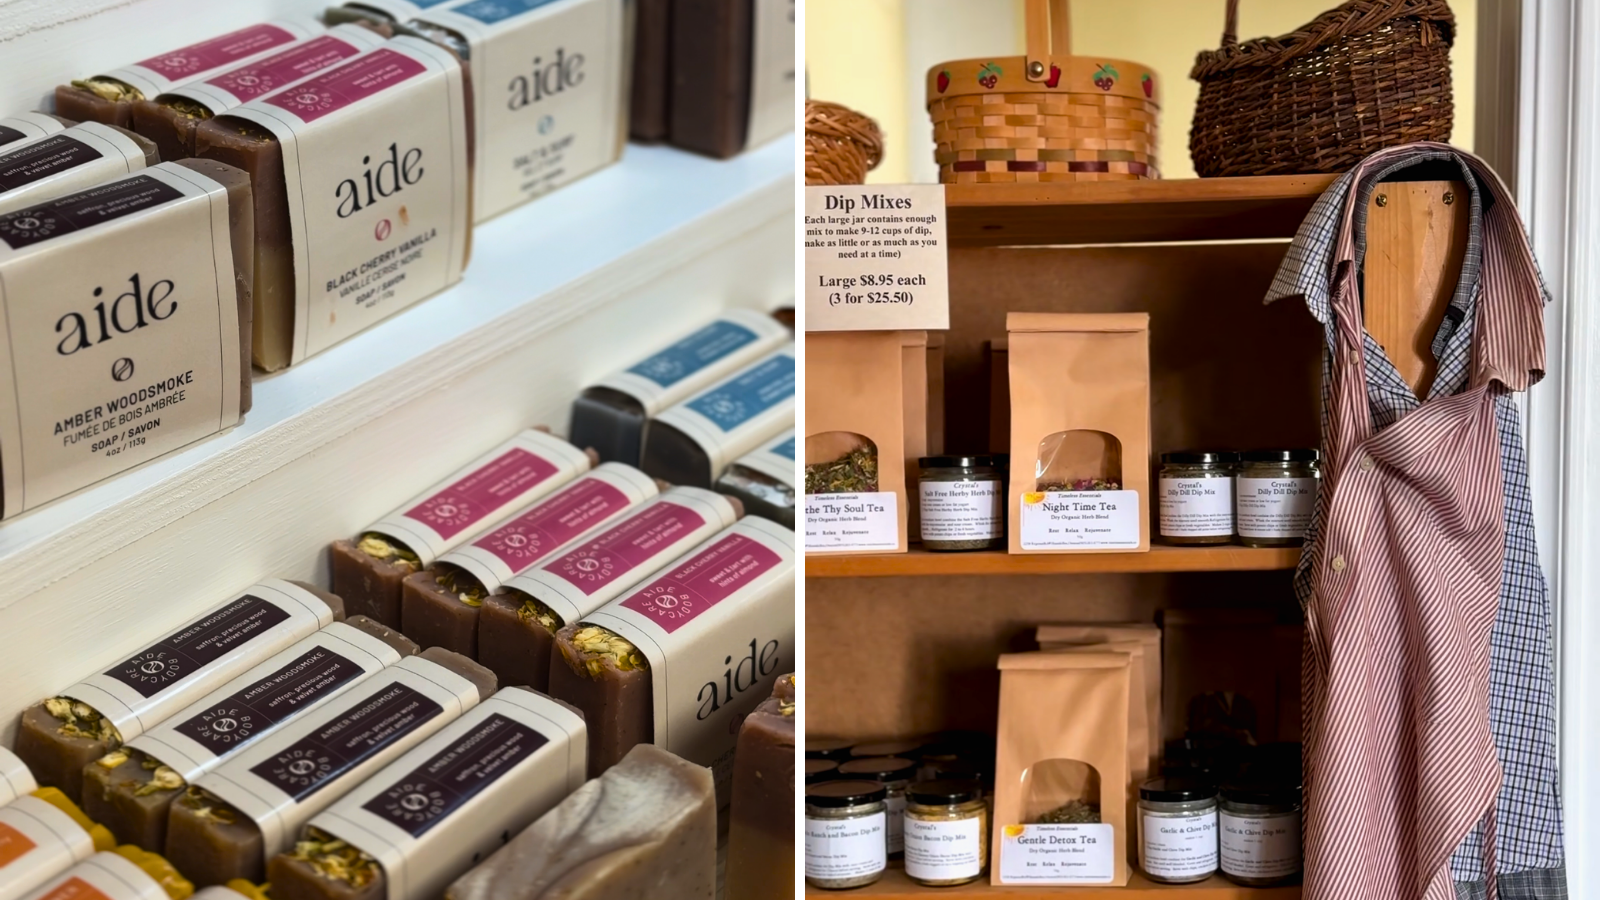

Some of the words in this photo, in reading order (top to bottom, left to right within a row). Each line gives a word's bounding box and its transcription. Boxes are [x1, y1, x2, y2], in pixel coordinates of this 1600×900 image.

[507, 47, 585, 112] aide
[335, 142, 424, 219] aide
[825, 195, 855, 214] Dip
[861, 194, 912, 210] Mixes
[805, 216, 826, 224] Each
[828, 215, 850, 225] large
[851, 215, 865, 225] jar
[867, 215, 904, 223] contains
[905, 214, 937, 225] enough
[806, 228, 823, 236] mix
[836, 227, 859, 235] make
[861, 226, 880, 235] 9-12
[882, 227, 902, 236] cups
[904, 226, 914, 234] of
[915, 226, 932, 236] dip,
[838, 238, 858, 247] little
[883, 238, 908, 246] much
[921, 239, 937, 248] you
[838, 250, 858, 258] need
[860, 250, 869, 258] at
[878, 249, 901, 259] time)
[325, 268, 358, 293] BLACK
[359, 248, 397, 275] CHERRY
[398, 227, 437, 255] VANILLA
[338, 272, 371, 299] VANILLE
[371, 259, 399, 283] CERISE
[399, 247, 423, 267] NOIRE
[819, 275, 857, 289] Large
[860, 274, 894, 286] $8.95
[897, 274, 926, 286] each
[829, 292, 841, 306] (3
[845, 292, 864, 304] for
[867, 291, 914, 305] $25.50)
[55, 272, 178, 355] aide
[53, 405, 103, 435] AMBER
[106, 370, 194, 414] WOODSMOKE
[63, 423, 100, 447] FUMÉE
[102, 417, 117, 432] DE
[118, 407, 143, 425] BOIS
[144, 389, 187, 415] AMBRÉE
[91, 435, 119, 452] SOAP
[128, 418, 161, 437] SAVON
[105, 446, 121, 457] 4oz
[129, 436, 147, 449] 113g
[924, 490, 933, 498] Salt
[949, 490, 969, 498] Herby
[1168, 489, 1179, 497] Dilly
[1257, 488, 1272, 496] Dilly
[1286, 488, 1297, 496] Dip
[822, 504, 841, 515] Thy
[844, 504, 864, 512] Soul
[866, 503, 884, 512] Tea
[1042, 502, 1069, 513] Night
[1072, 502, 1096, 511] Time
[1099, 502, 1117, 511] Tea
[563, 556, 613, 581] BODYCARE
[565, 550, 598, 562] AIDE
[674, 565, 697, 579] BLACK
[695, 551, 718, 568] CHERRY
[717, 536, 743, 553] VANILLA
[718, 576, 734, 587] hints
[734, 571, 739, 579] of
[739, 560, 759, 575] almond
[643, 586, 675, 598] AIDE
[641, 593, 693, 619] BODYCARE
[172, 626, 202, 644] AMBER
[201, 598, 253, 627] WOODSMOKE
[195, 635, 223, 650] saffron,
[222, 618, 250, 637] precious
[249, 608, 267, 620] wood
[222, 630, 243, 644] velvet
[242, 619, 263, 634] amber
[126, 658, 180, 683] BODYCARE
[131, 652, 167, 665] AIDE
[244, 681, 275, 700] AMBER
[272, 651, 325, 683] WOODSMOKE
[268, 690, 296, 707] saffron,
[294, 673, 323, 693] precious
[322, 663, 341, 676] wood
[296, 686, 317, 701] velvet
[315, 675, 337, 690] amber
[697, 638, 778, 721] aide
[202, 708, 238, 722] AIDE
[319, 719, 351, 740] AMBER
[350, 688, 403, 721] WOODSMOKE
[346, 730, 374, 748] saffron,
[372, 711, 401, 733] precious
[400, 700, 419, 715] wood
[197, 715, 253, 743] BODYCARE
[366, 738, 375, 746] &
[374, 726, 395, 742] velvet
[394, 713, 416, 729] amber
[278, 749, 316, 764] AIDE
[427, 752, 458, 774] AMBER
[455, 718, 505, 754] WOODSMOKE
[1017, 835, 1046, 845] Gentle
[1049, 835, 1077, 844] Detox
[1079, 835, 1097, 844] Tea
